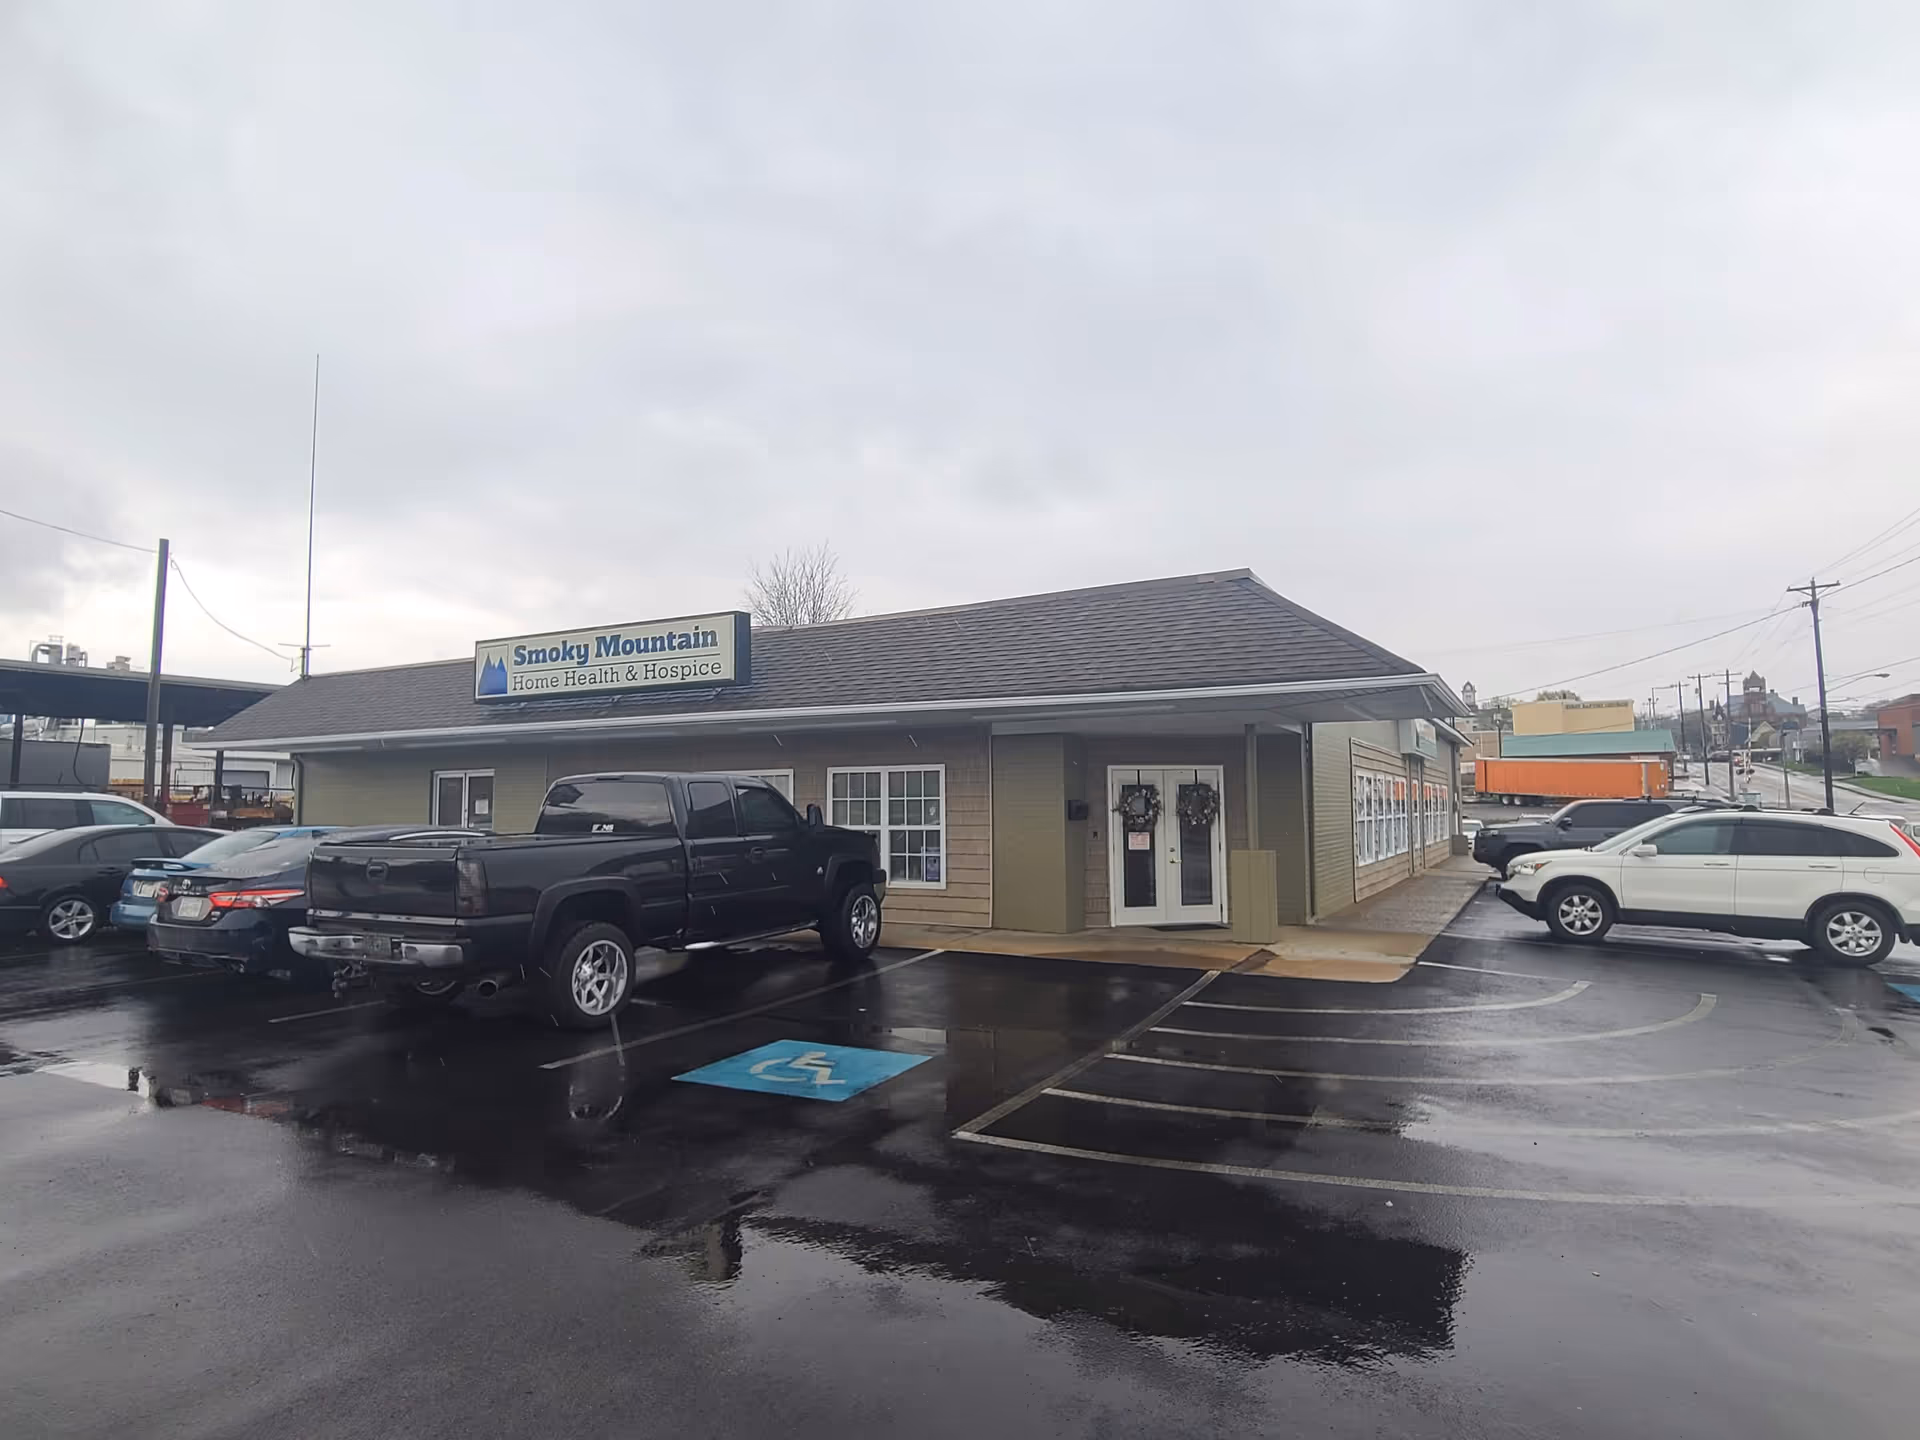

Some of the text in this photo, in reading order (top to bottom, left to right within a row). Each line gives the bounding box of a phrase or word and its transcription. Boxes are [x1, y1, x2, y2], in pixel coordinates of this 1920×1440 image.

[513, 626, 718, 665] Smoky Mountain
[512, 659, 722, 691] Home Health & Hospice
